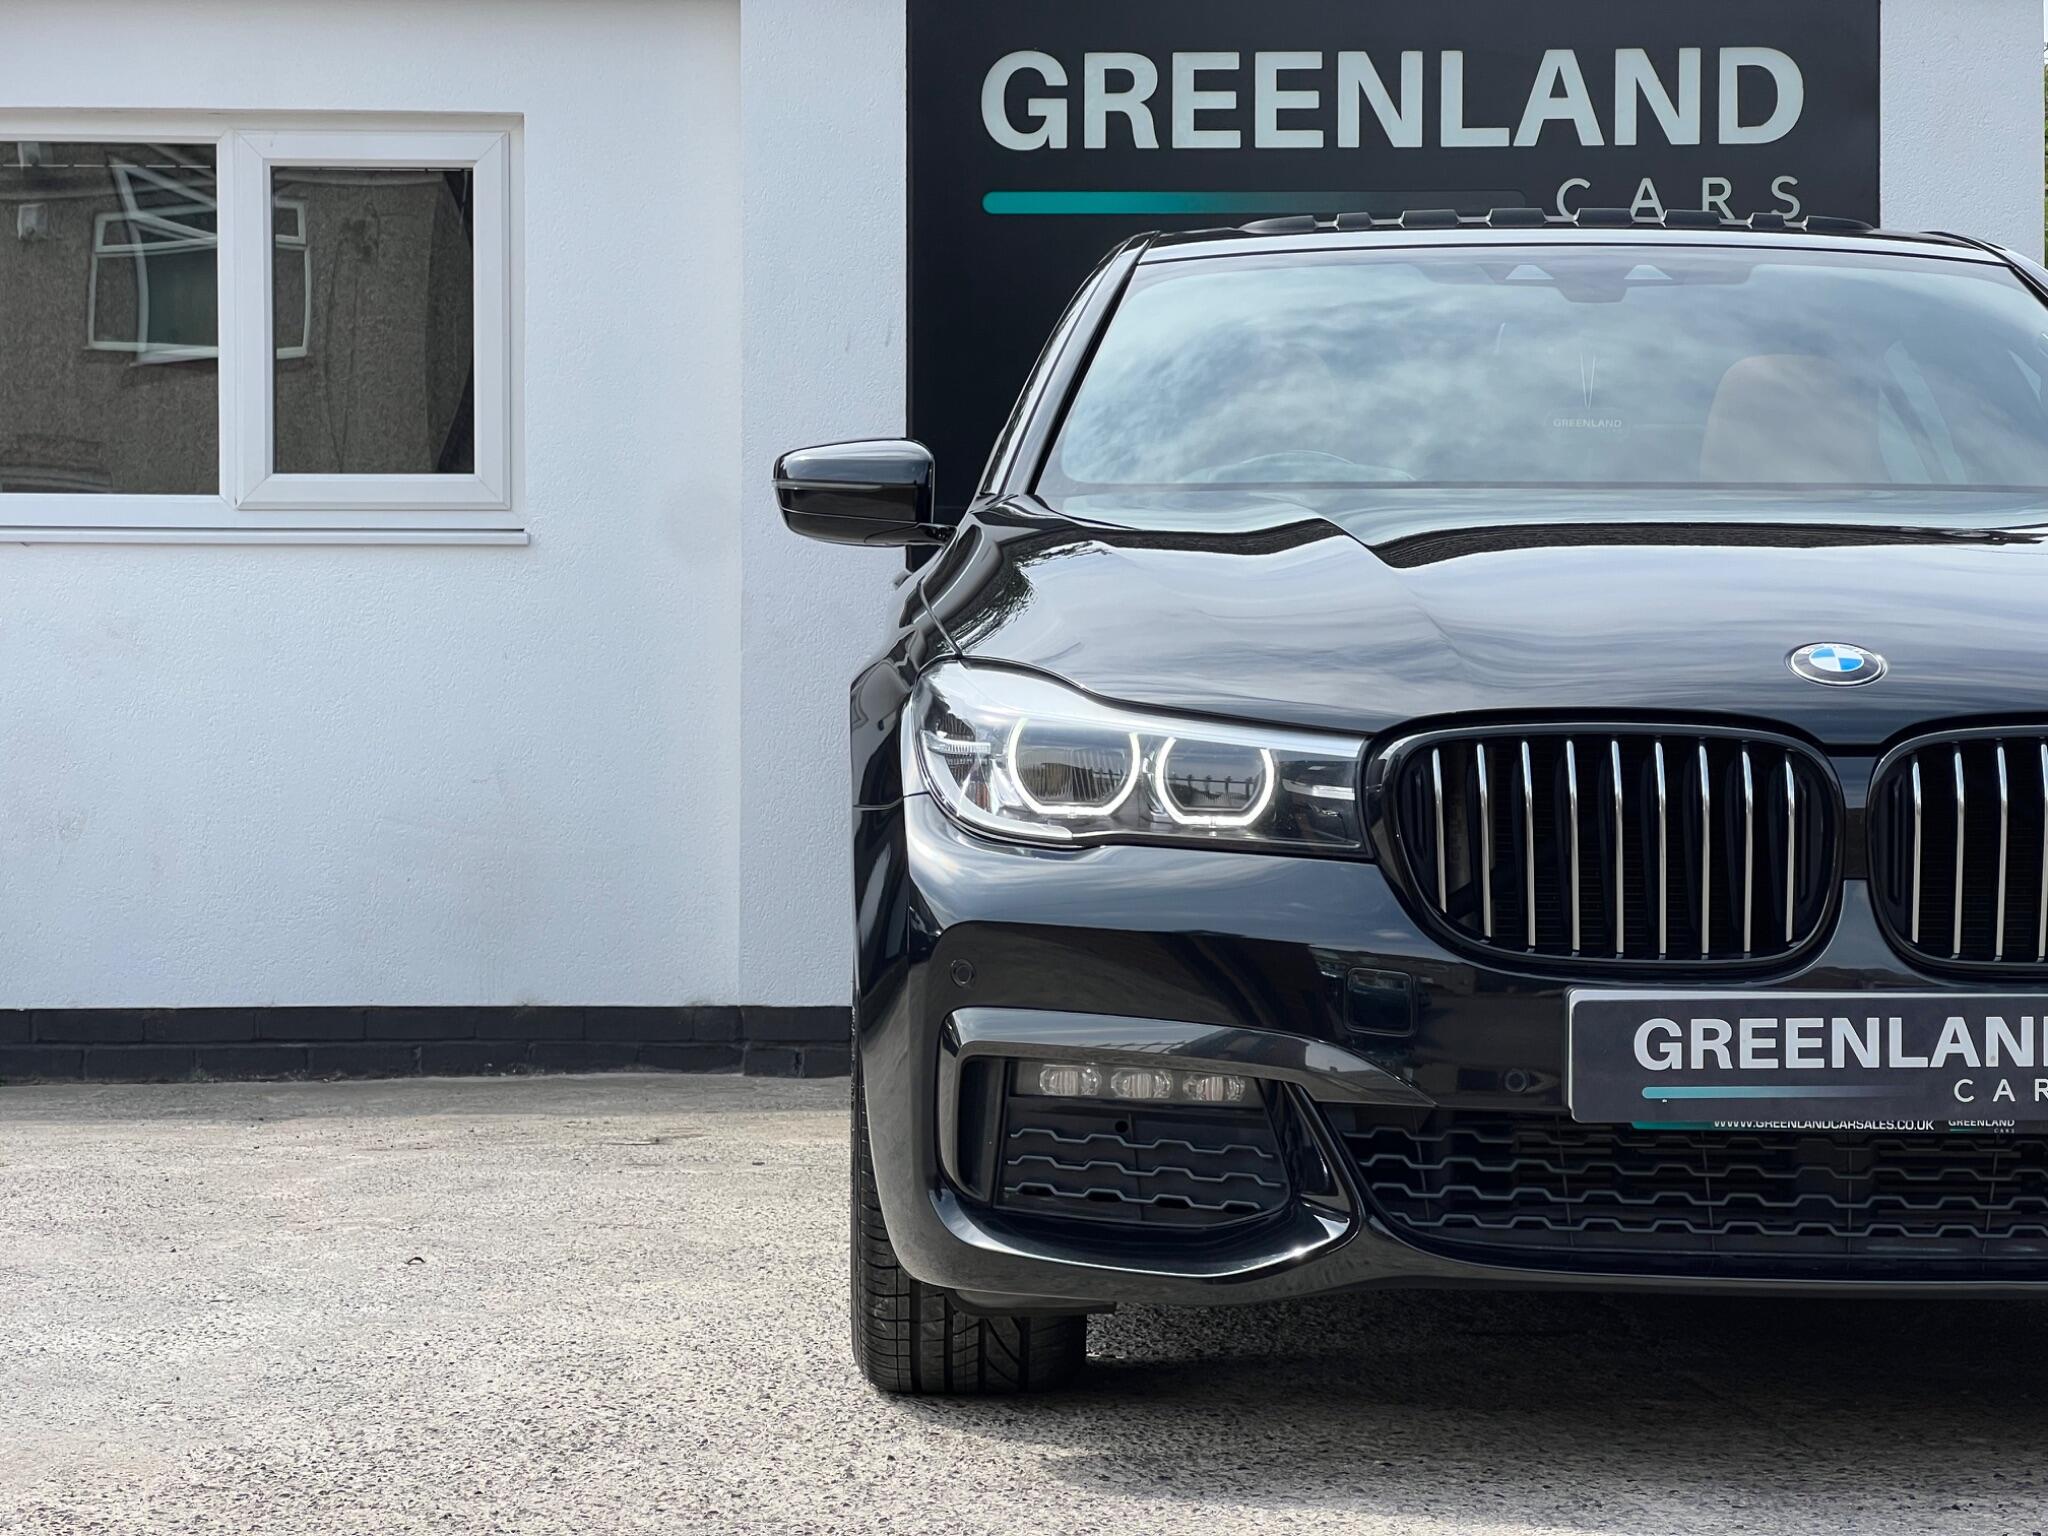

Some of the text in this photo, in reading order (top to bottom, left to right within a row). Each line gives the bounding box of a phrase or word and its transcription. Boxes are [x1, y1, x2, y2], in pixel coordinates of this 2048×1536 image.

[981, 47, 1804, 151] GREENLAND
[1556, 175, 1801, 220] CARS
[1552, 417, 1623, 428] GREENLAND
[1633, 1015, 2048, 1070] GREENLAN
[1713, 1119, 1935, 1131] WWW.GREENLANDCARSALES.CO.UK
[1948, 1119, 2015, 1127] GREENLAND
